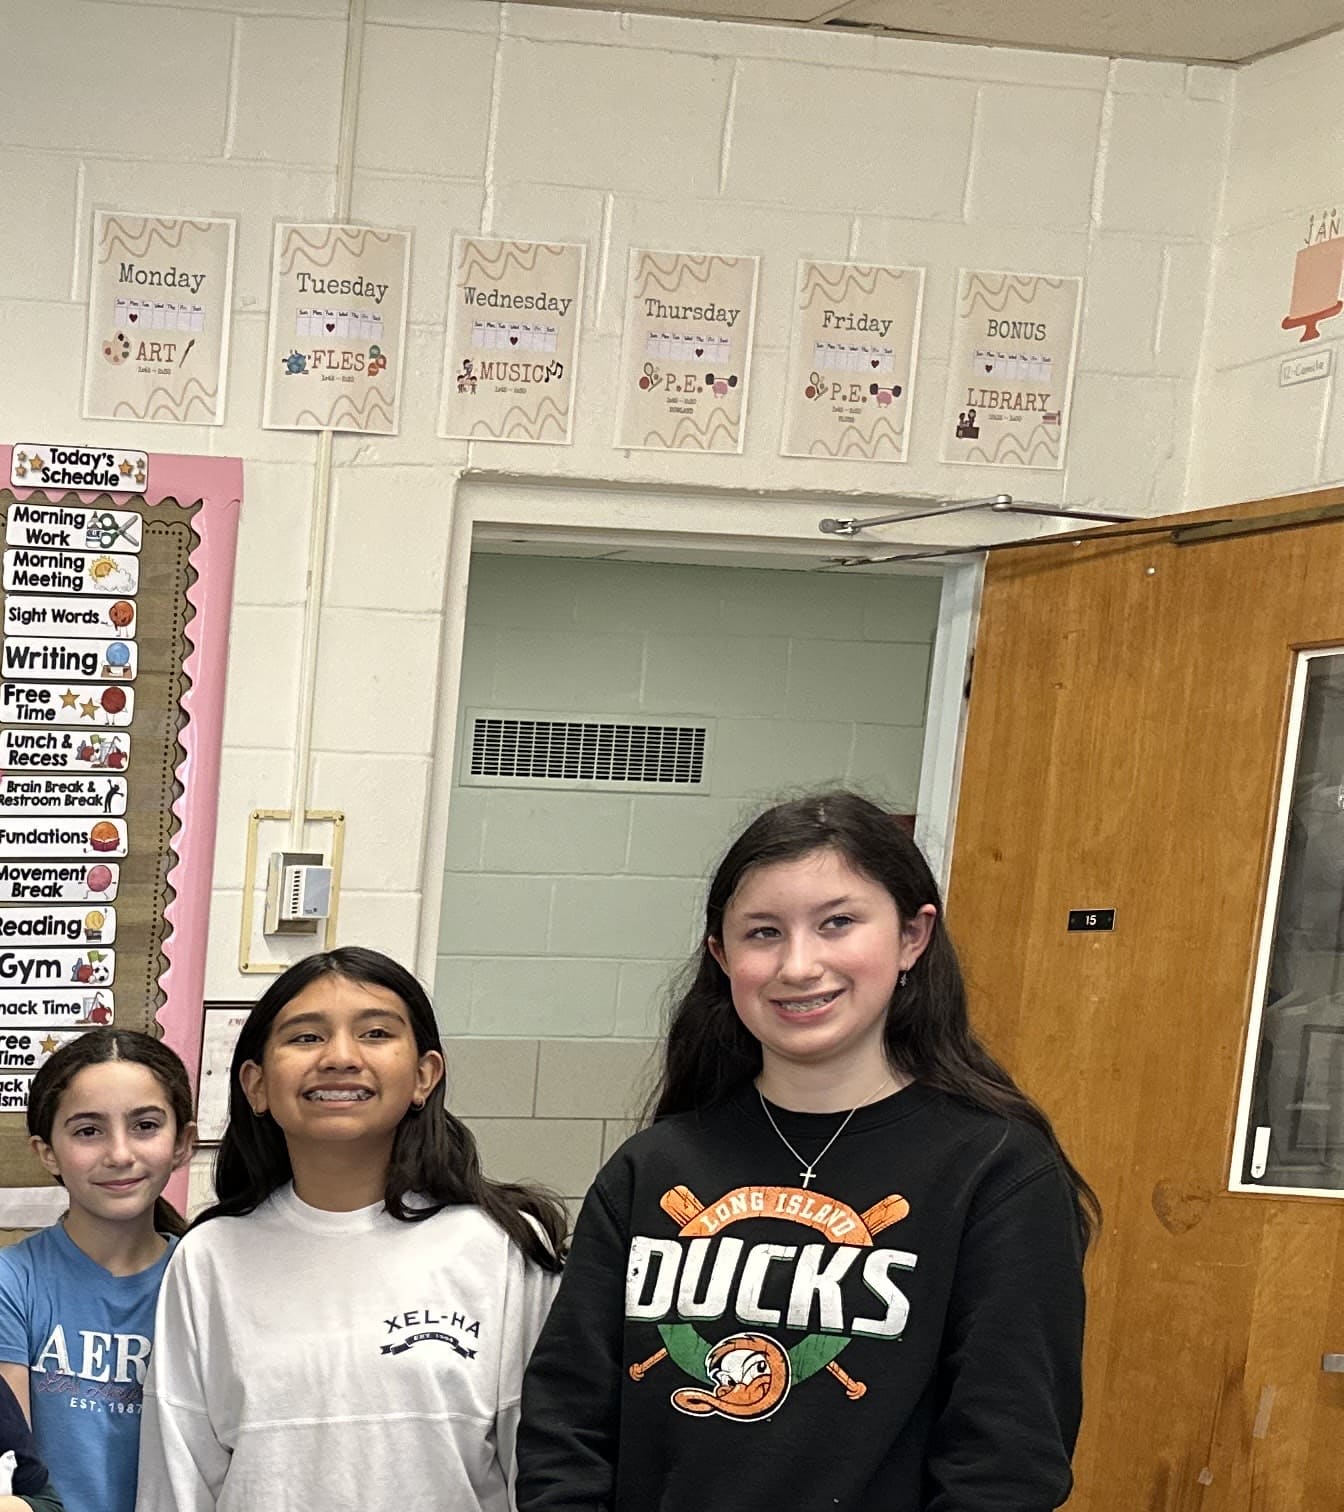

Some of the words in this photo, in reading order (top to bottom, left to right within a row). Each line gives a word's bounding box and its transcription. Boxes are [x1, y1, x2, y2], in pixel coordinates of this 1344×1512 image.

[119, 262, 206, 295] Monday
[297, 272, 389, 304] Tuesday
[463, 286, 573, 316] Wednesday
[645, 298, 741, 328] Thursday
[822, 310, 893, 337] Friday
[987, 319, 1047, 341] BONUS
[135, 341, 177, 363] ART
[312, 350, 365, 372] FLES
[480, 362, 544, 383] MUSIC
[664, 374, 703, 393] P.E.
[830, 383, 867, 403] P.E.
[966, 388, 1051, 412] LIBRARY
[50, 449, 115, 471] Today's
[42, 467, 120, 488] Schedule
[13, 508, 85, 530] Morning
[26, 528, 70, 547] Work
[13, 553, 85, 573] Morning
[12, 571, 84, 591] Meeting
[9, 607, 46, 625] Sight
[51, 609, 100, 624] Words
[6, 647, 98, 675] Writing
[4, 685, 51, 705] Free
[16, 703, 56, 721] Time
[6, 732, 54, 750] Lunch
[60, 733, 73, 748] &
[8, 749, 68, 767] Recess
[7, 780, 42, 793] Brain
[45, 780, 83, 793] Break
[87, 781, 96, 793] &
[64, 794, 103, 807] Break
[11, 880, 63, 898] Break
[1085, 914, 1097, 926] 15
[39, 1000, 81, 1016] Time
[701, 1191, 765, 1234] LONG
[775, 1193, 856, 1239] ISLAND
[625, 1236, 918, 1339] DUCKS
[383, 1309, 481, 1339] XEL-HA
[31, 1323, 152, 1385] AER
[70, 1397, 102, 1413] EST.
